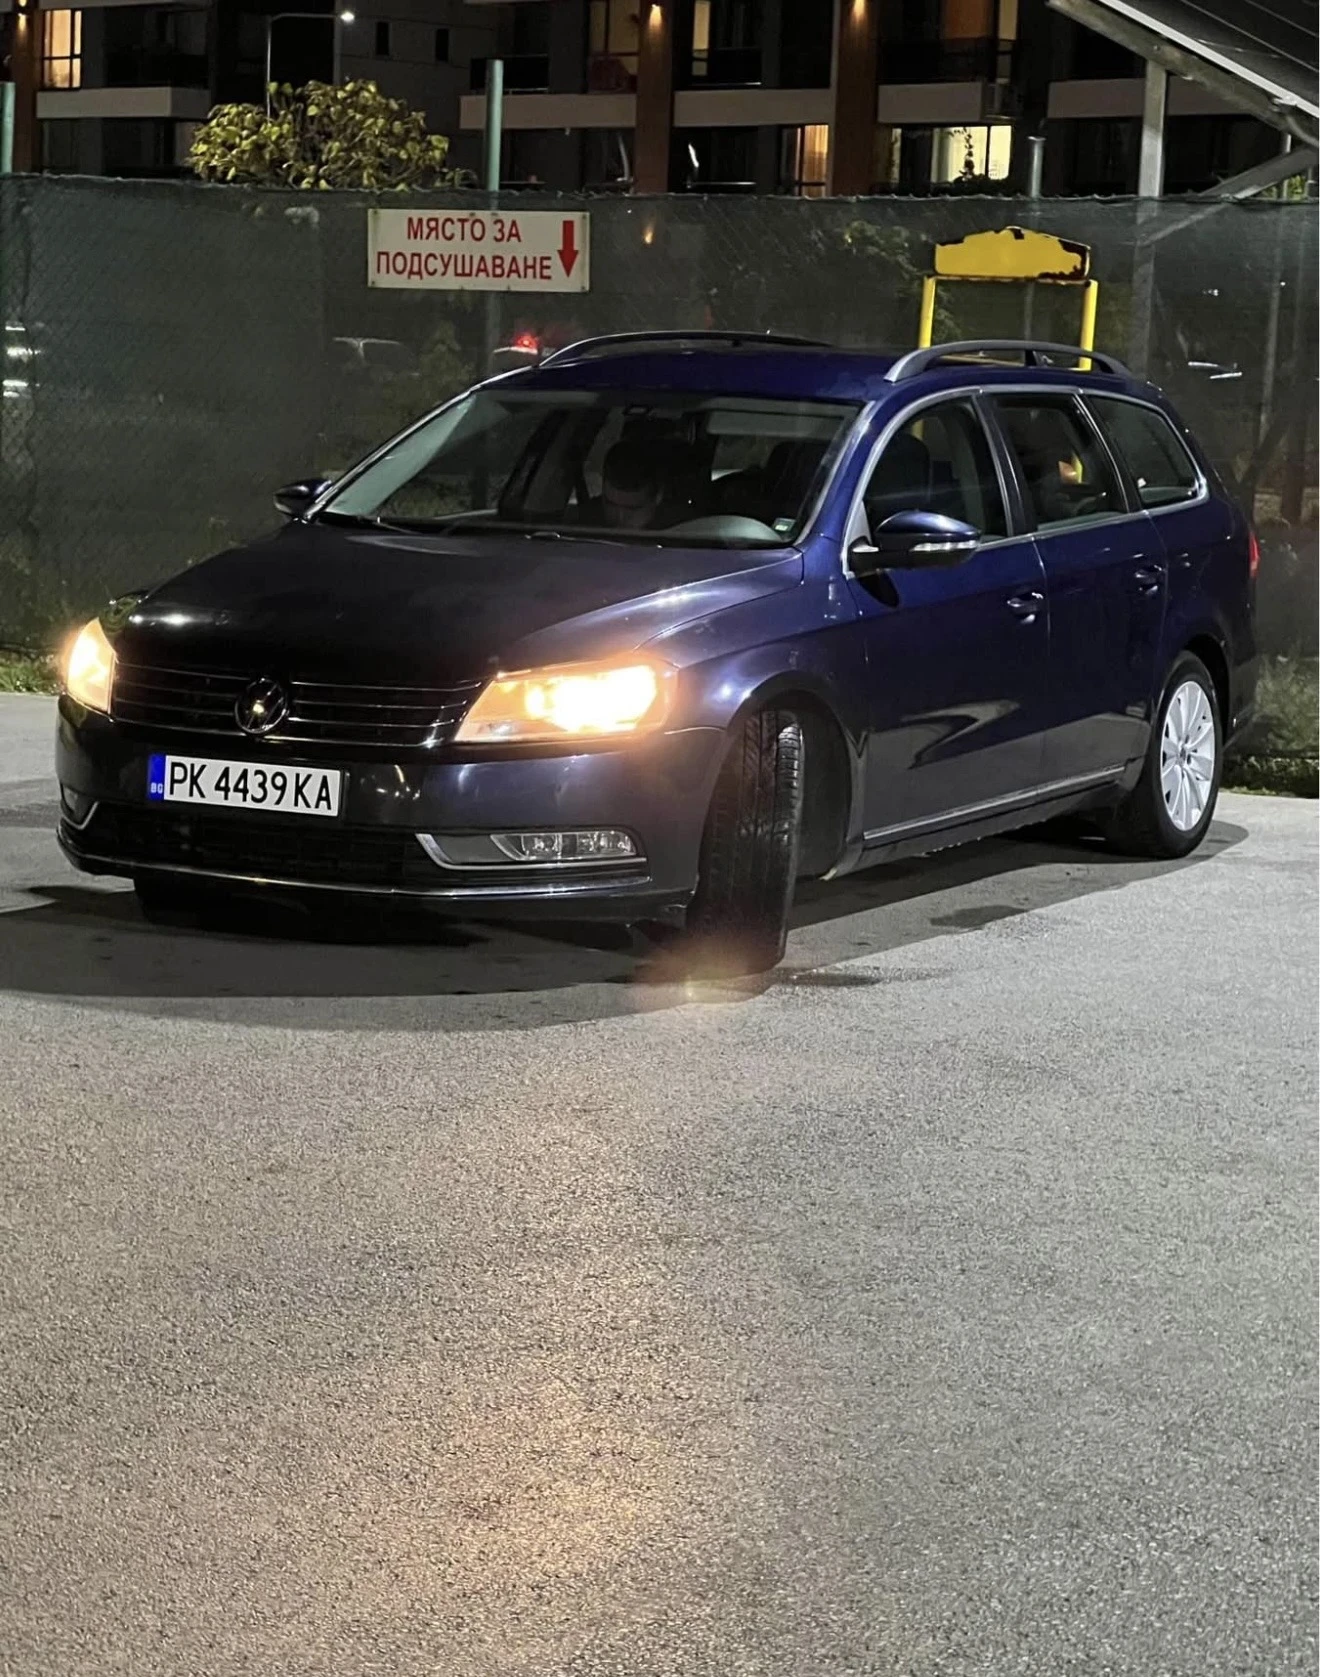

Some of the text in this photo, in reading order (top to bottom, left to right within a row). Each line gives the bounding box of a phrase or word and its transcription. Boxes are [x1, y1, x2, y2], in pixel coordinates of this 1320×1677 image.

[407, 217, 522, 243] МЯСТО ЗА
[376, 251, 552, 280] ПОДСУШАВАНЕ
[169, 762, 332, 810] PK 4439 KA
